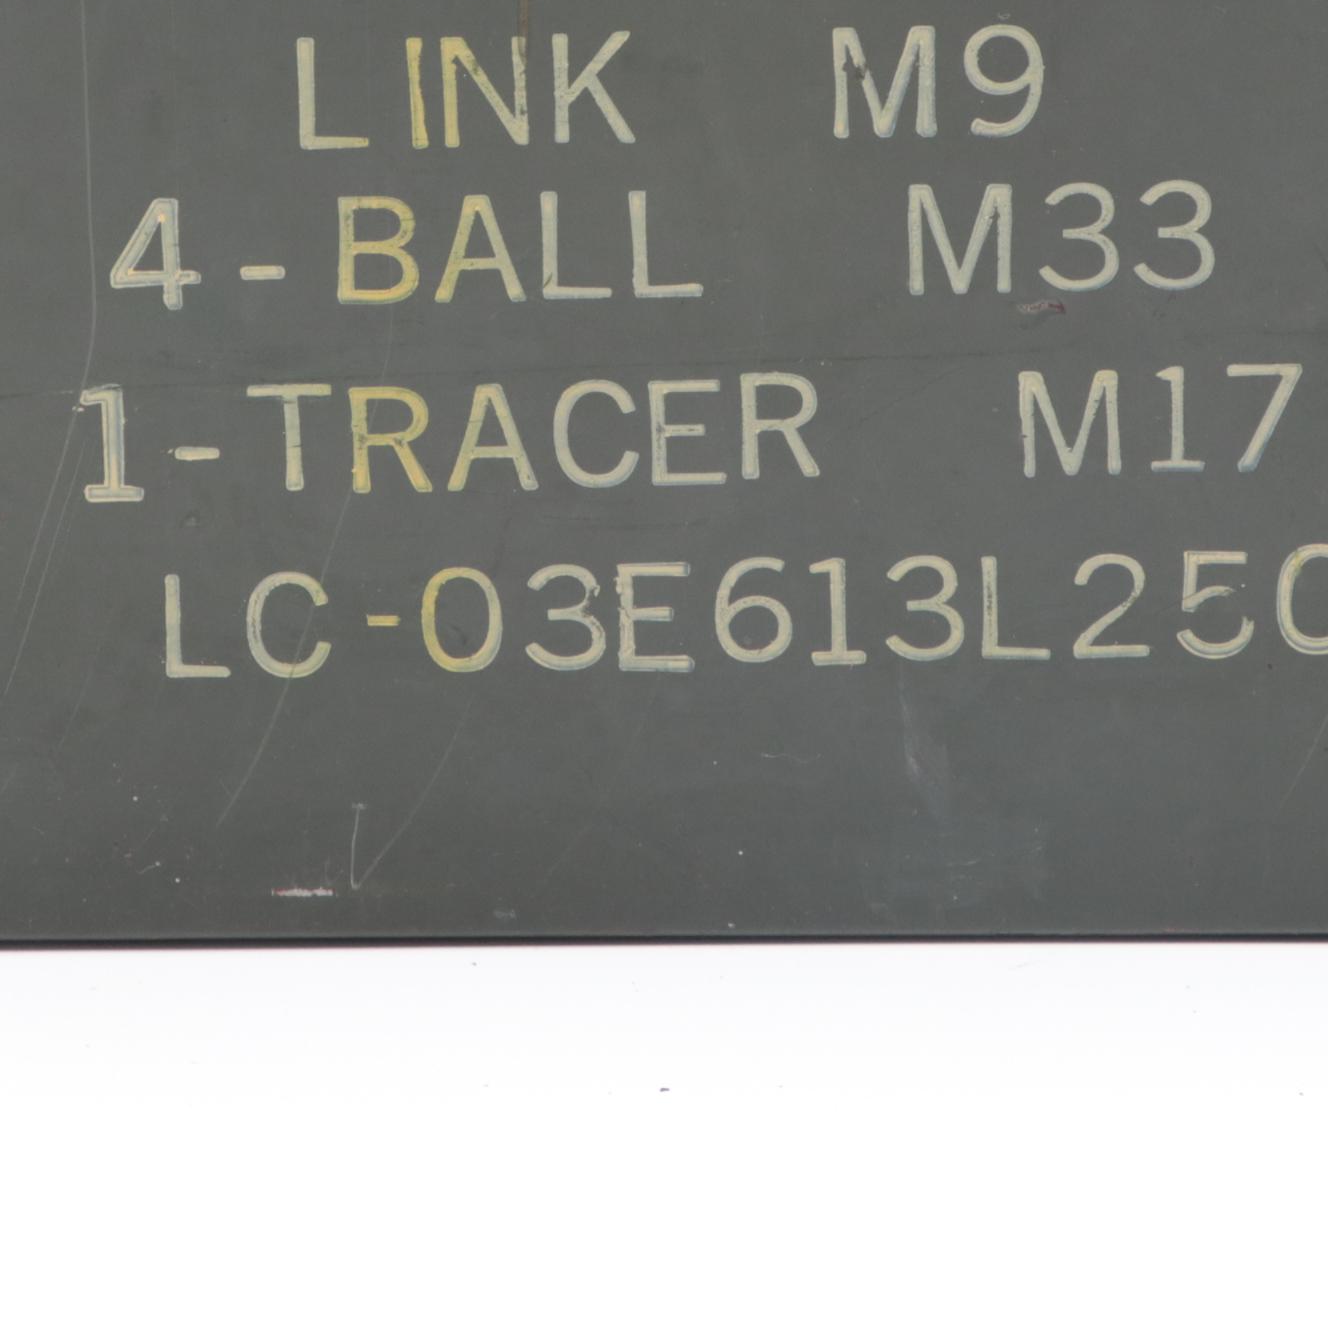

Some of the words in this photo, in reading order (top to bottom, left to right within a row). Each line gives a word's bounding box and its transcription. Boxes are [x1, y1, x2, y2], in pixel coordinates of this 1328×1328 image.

[296, 30, 636, 150] LINK
[831, 24, 1045, 138] M9
[907, 180, 1215, 295] M33
[1018, 363, 1303, 478] M17
